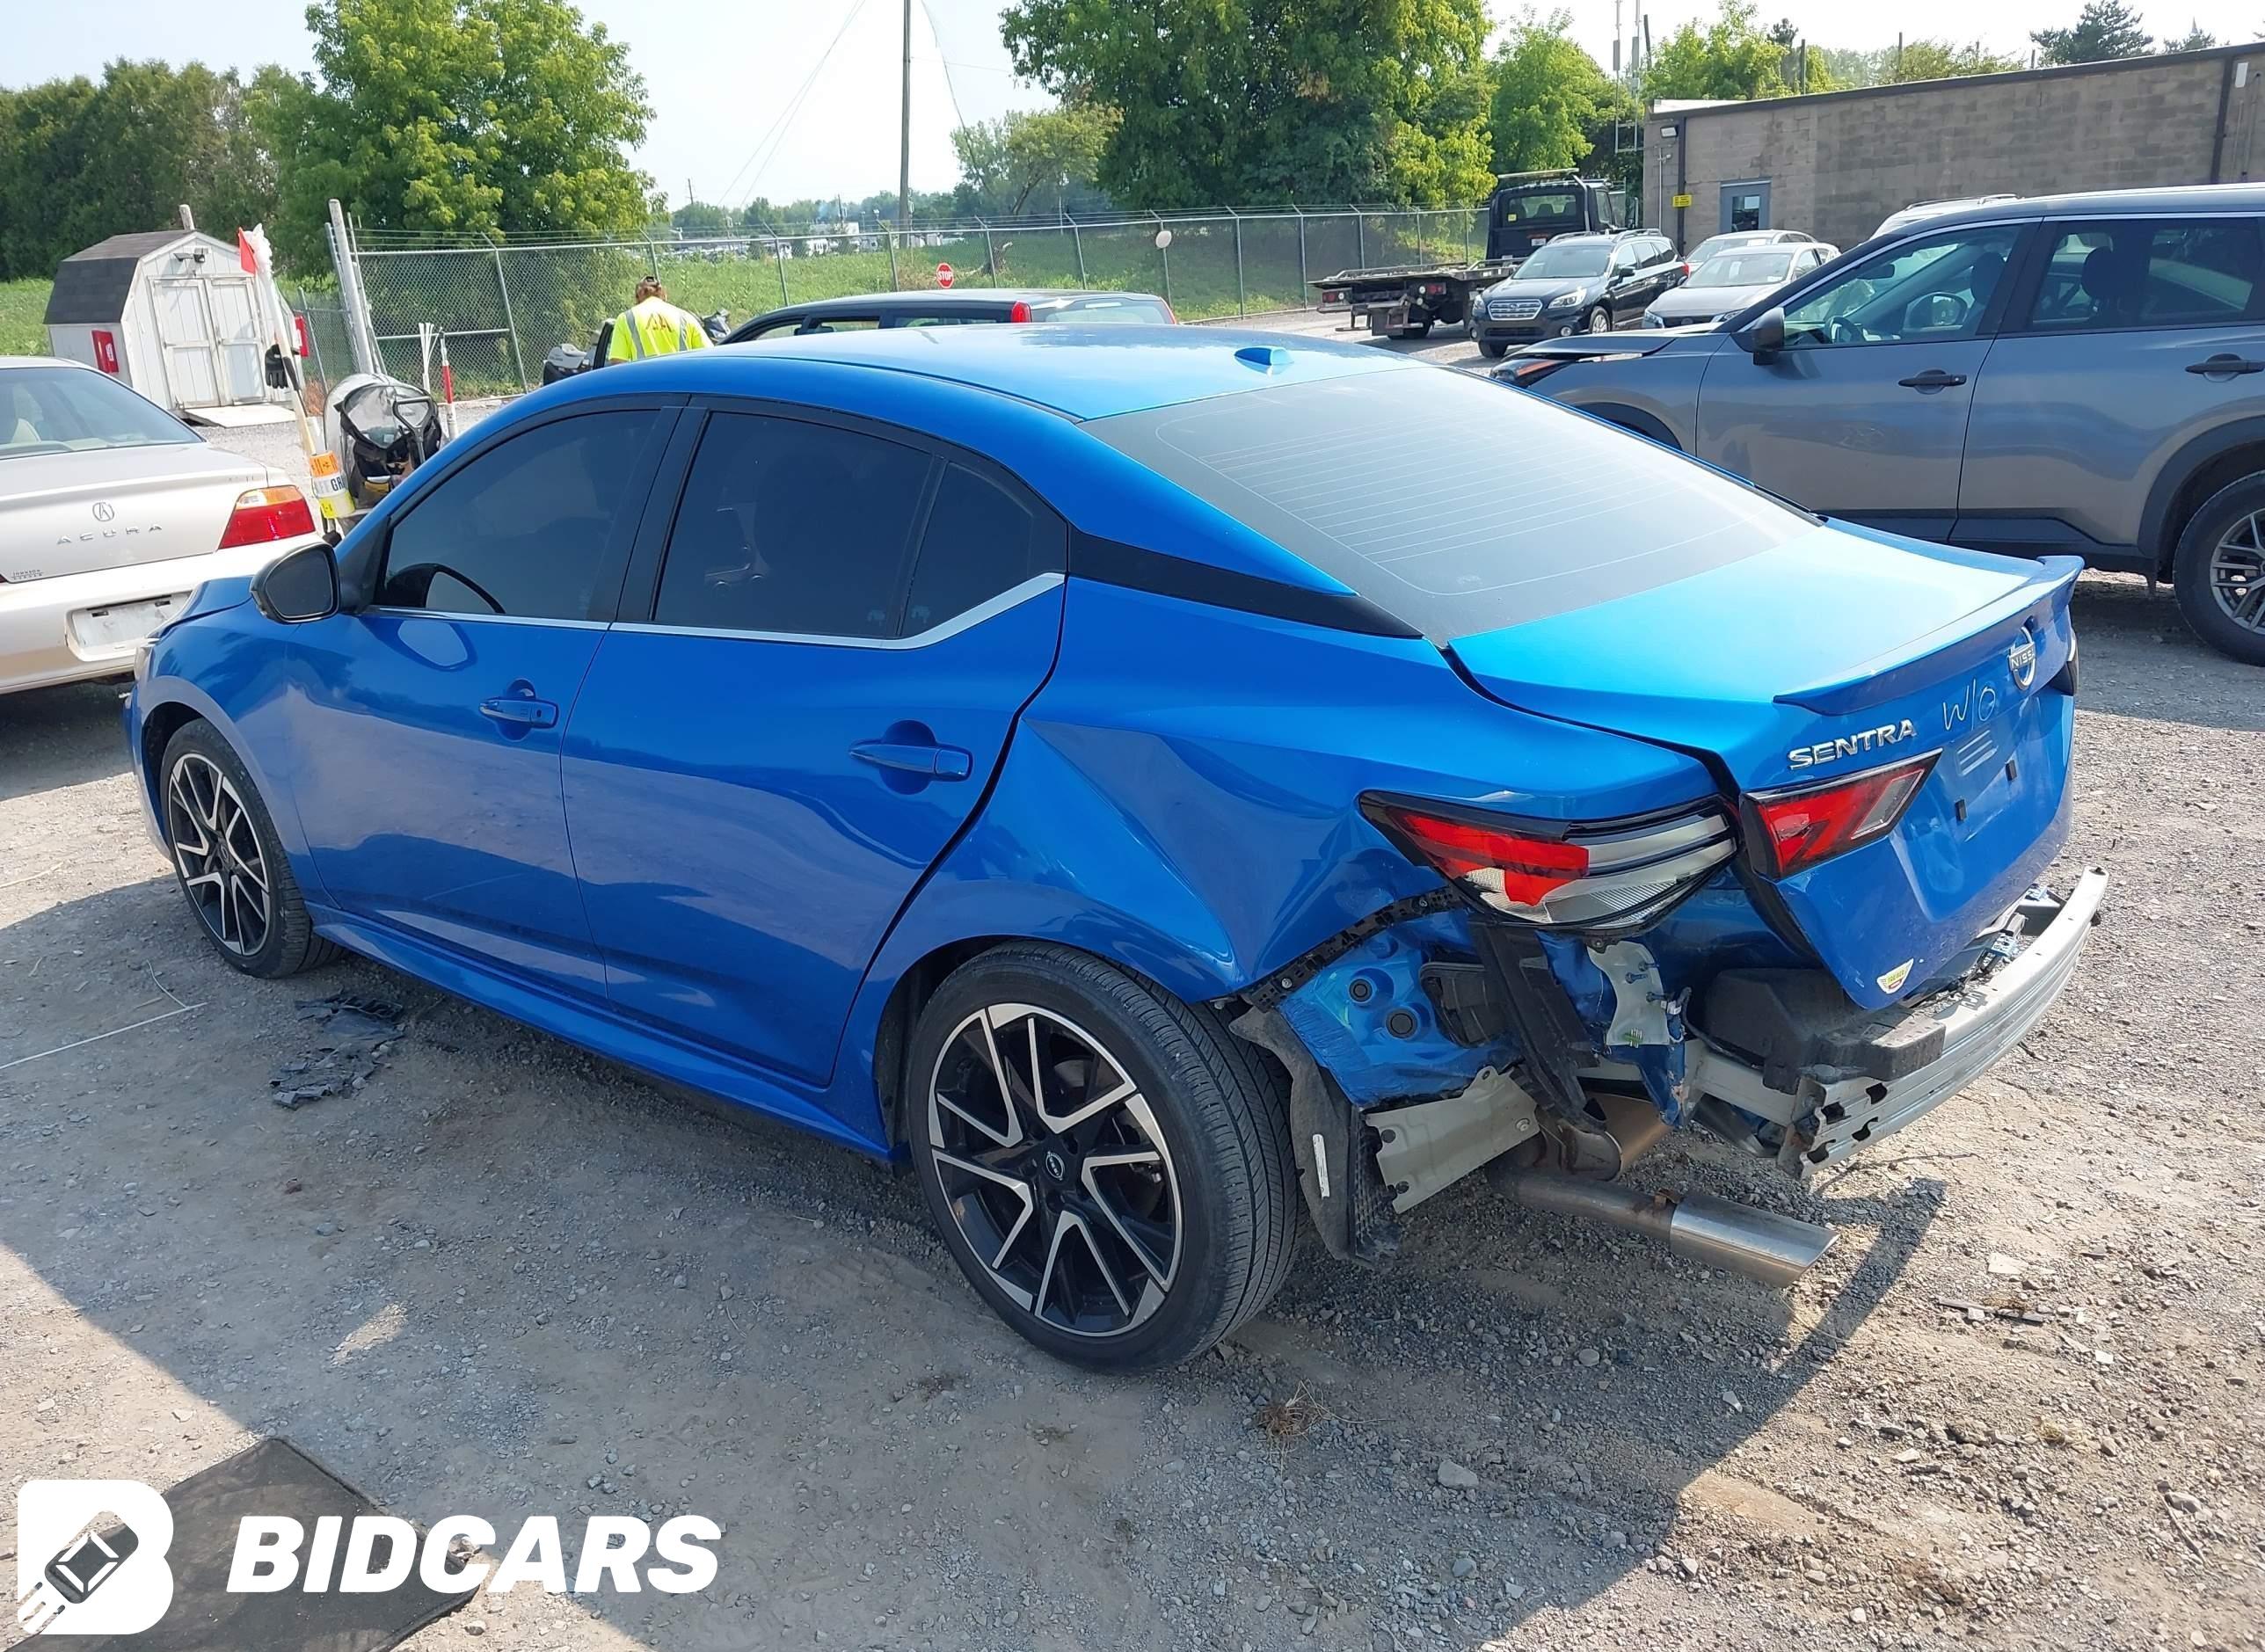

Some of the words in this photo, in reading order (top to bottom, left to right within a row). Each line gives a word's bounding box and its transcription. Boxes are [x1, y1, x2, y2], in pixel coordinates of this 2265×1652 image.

[938, 270, 953, 280] STOP
[57, 524, 163, 544] ACURA
[2010, 649, 2035, 669] NISS
[1788, 718, 1918, 771] SENTRA
